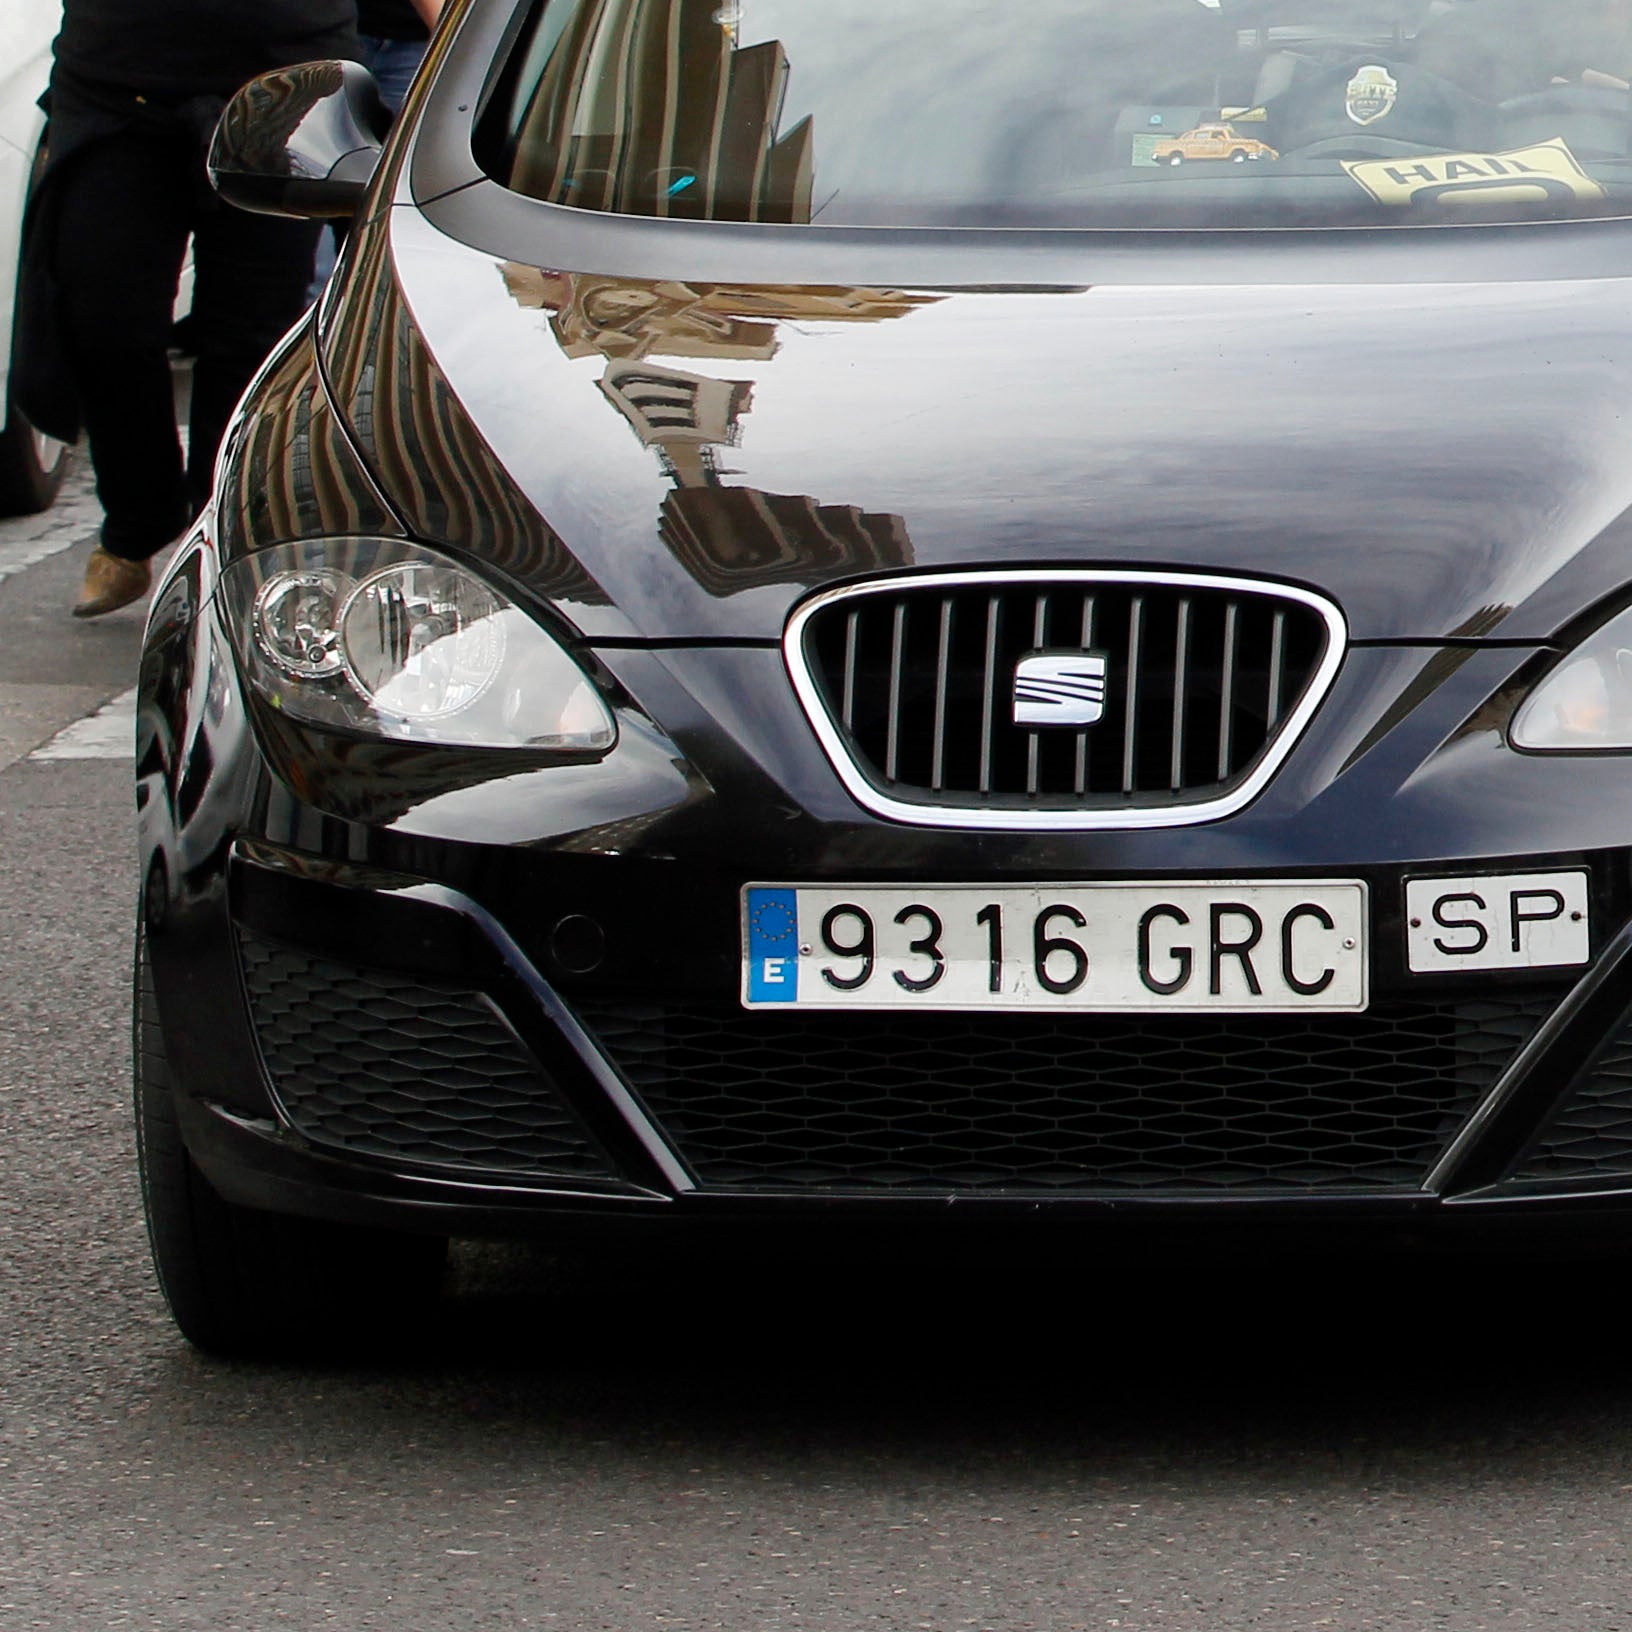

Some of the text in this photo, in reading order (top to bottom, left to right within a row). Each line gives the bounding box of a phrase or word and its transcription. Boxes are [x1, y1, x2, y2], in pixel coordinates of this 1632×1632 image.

[820, 901, 1336, 996] 9316 GRC
[1431, 888, 1566, 957] SP
[762, 957, 786, 985] E
